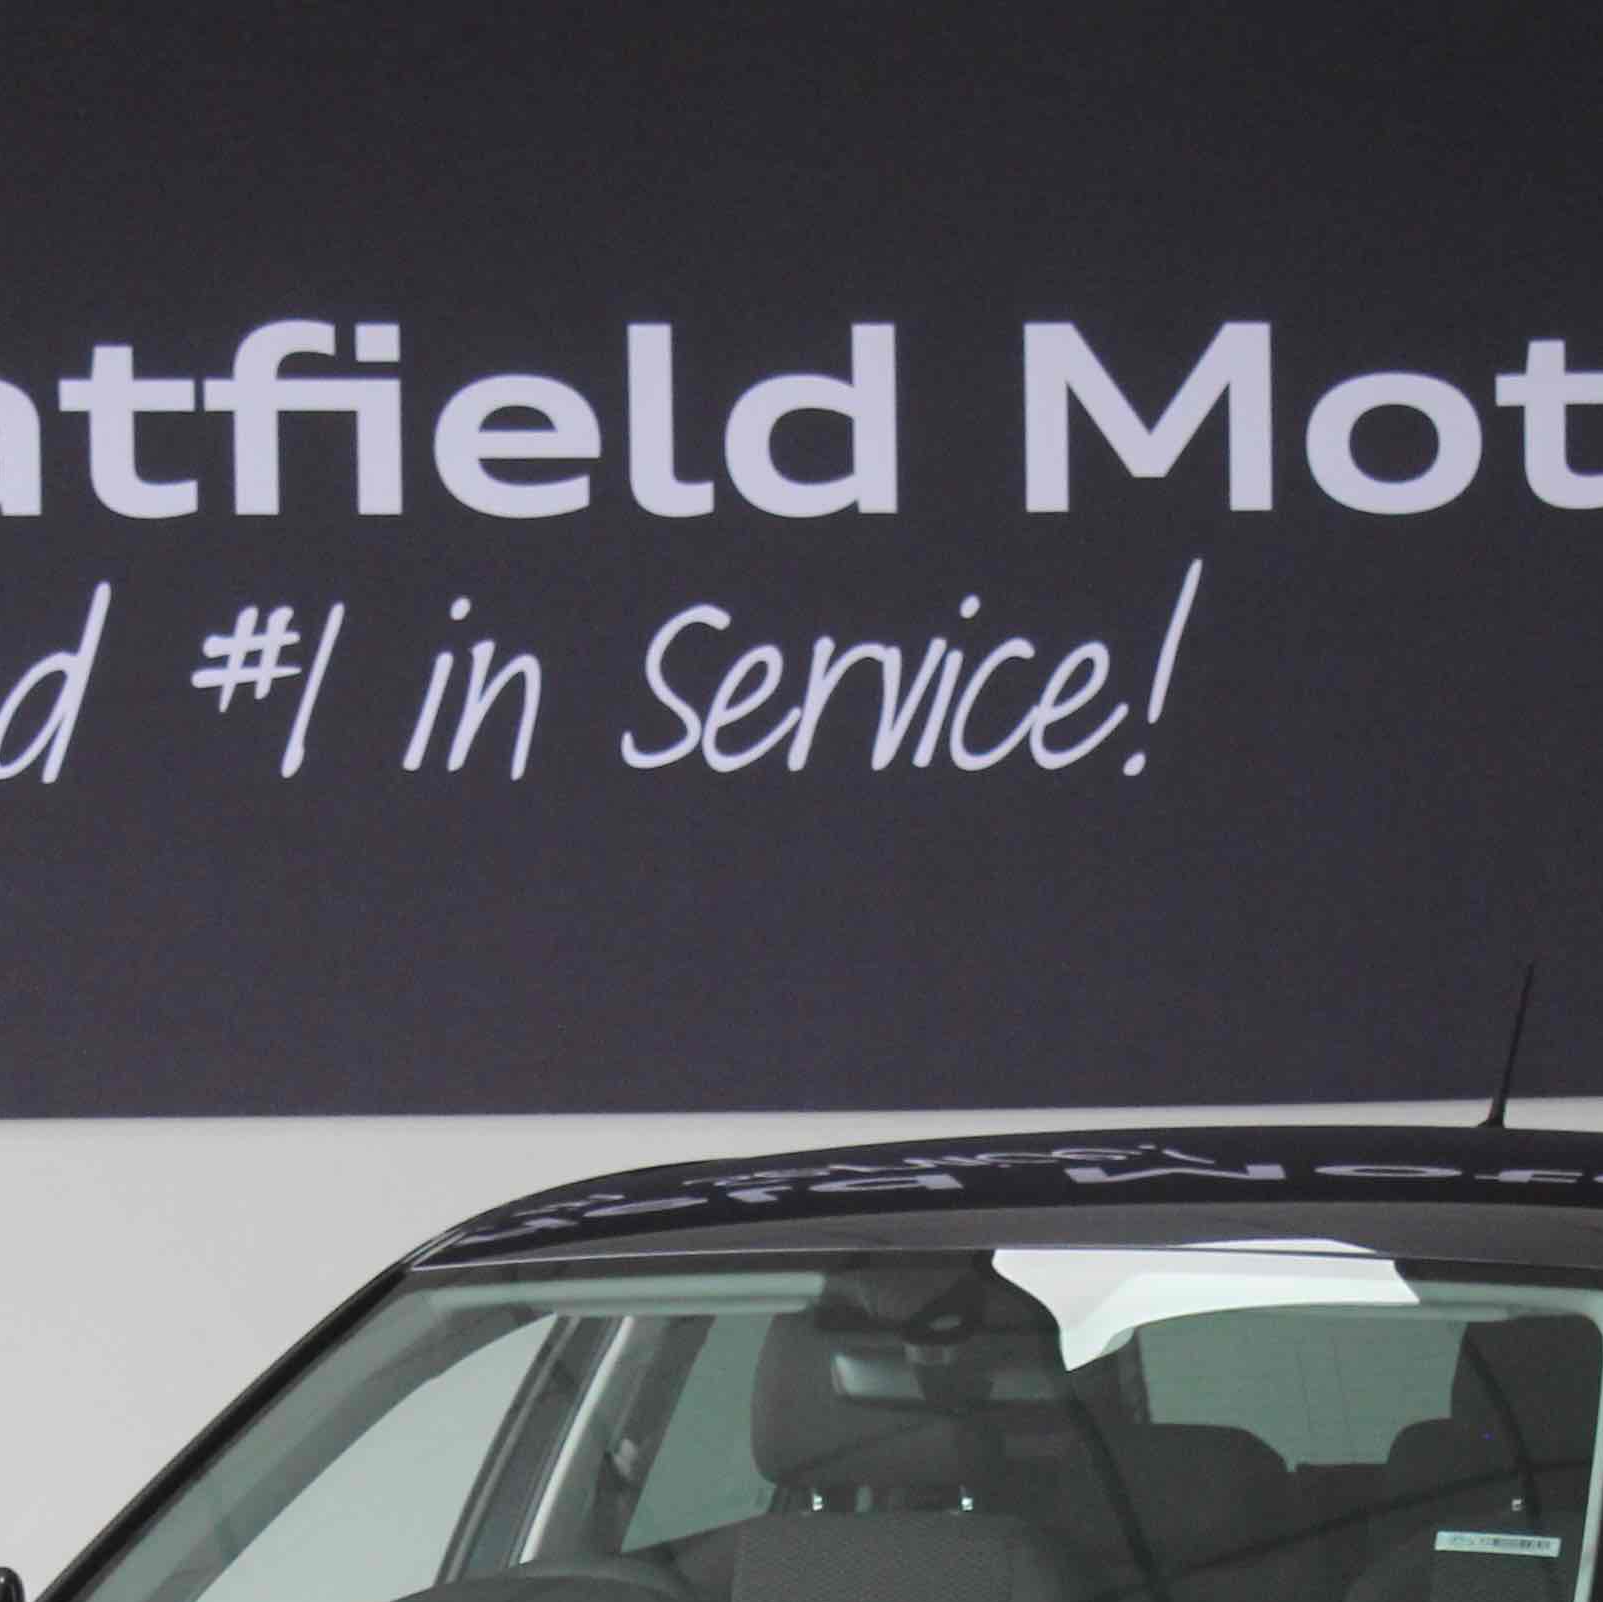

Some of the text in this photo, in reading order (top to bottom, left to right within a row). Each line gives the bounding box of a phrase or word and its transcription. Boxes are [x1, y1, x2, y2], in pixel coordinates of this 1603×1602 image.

[191, 603, 345, 778] #1
[402, 597, 541, 781] in
[621, 559, 1202, 776] Service!
